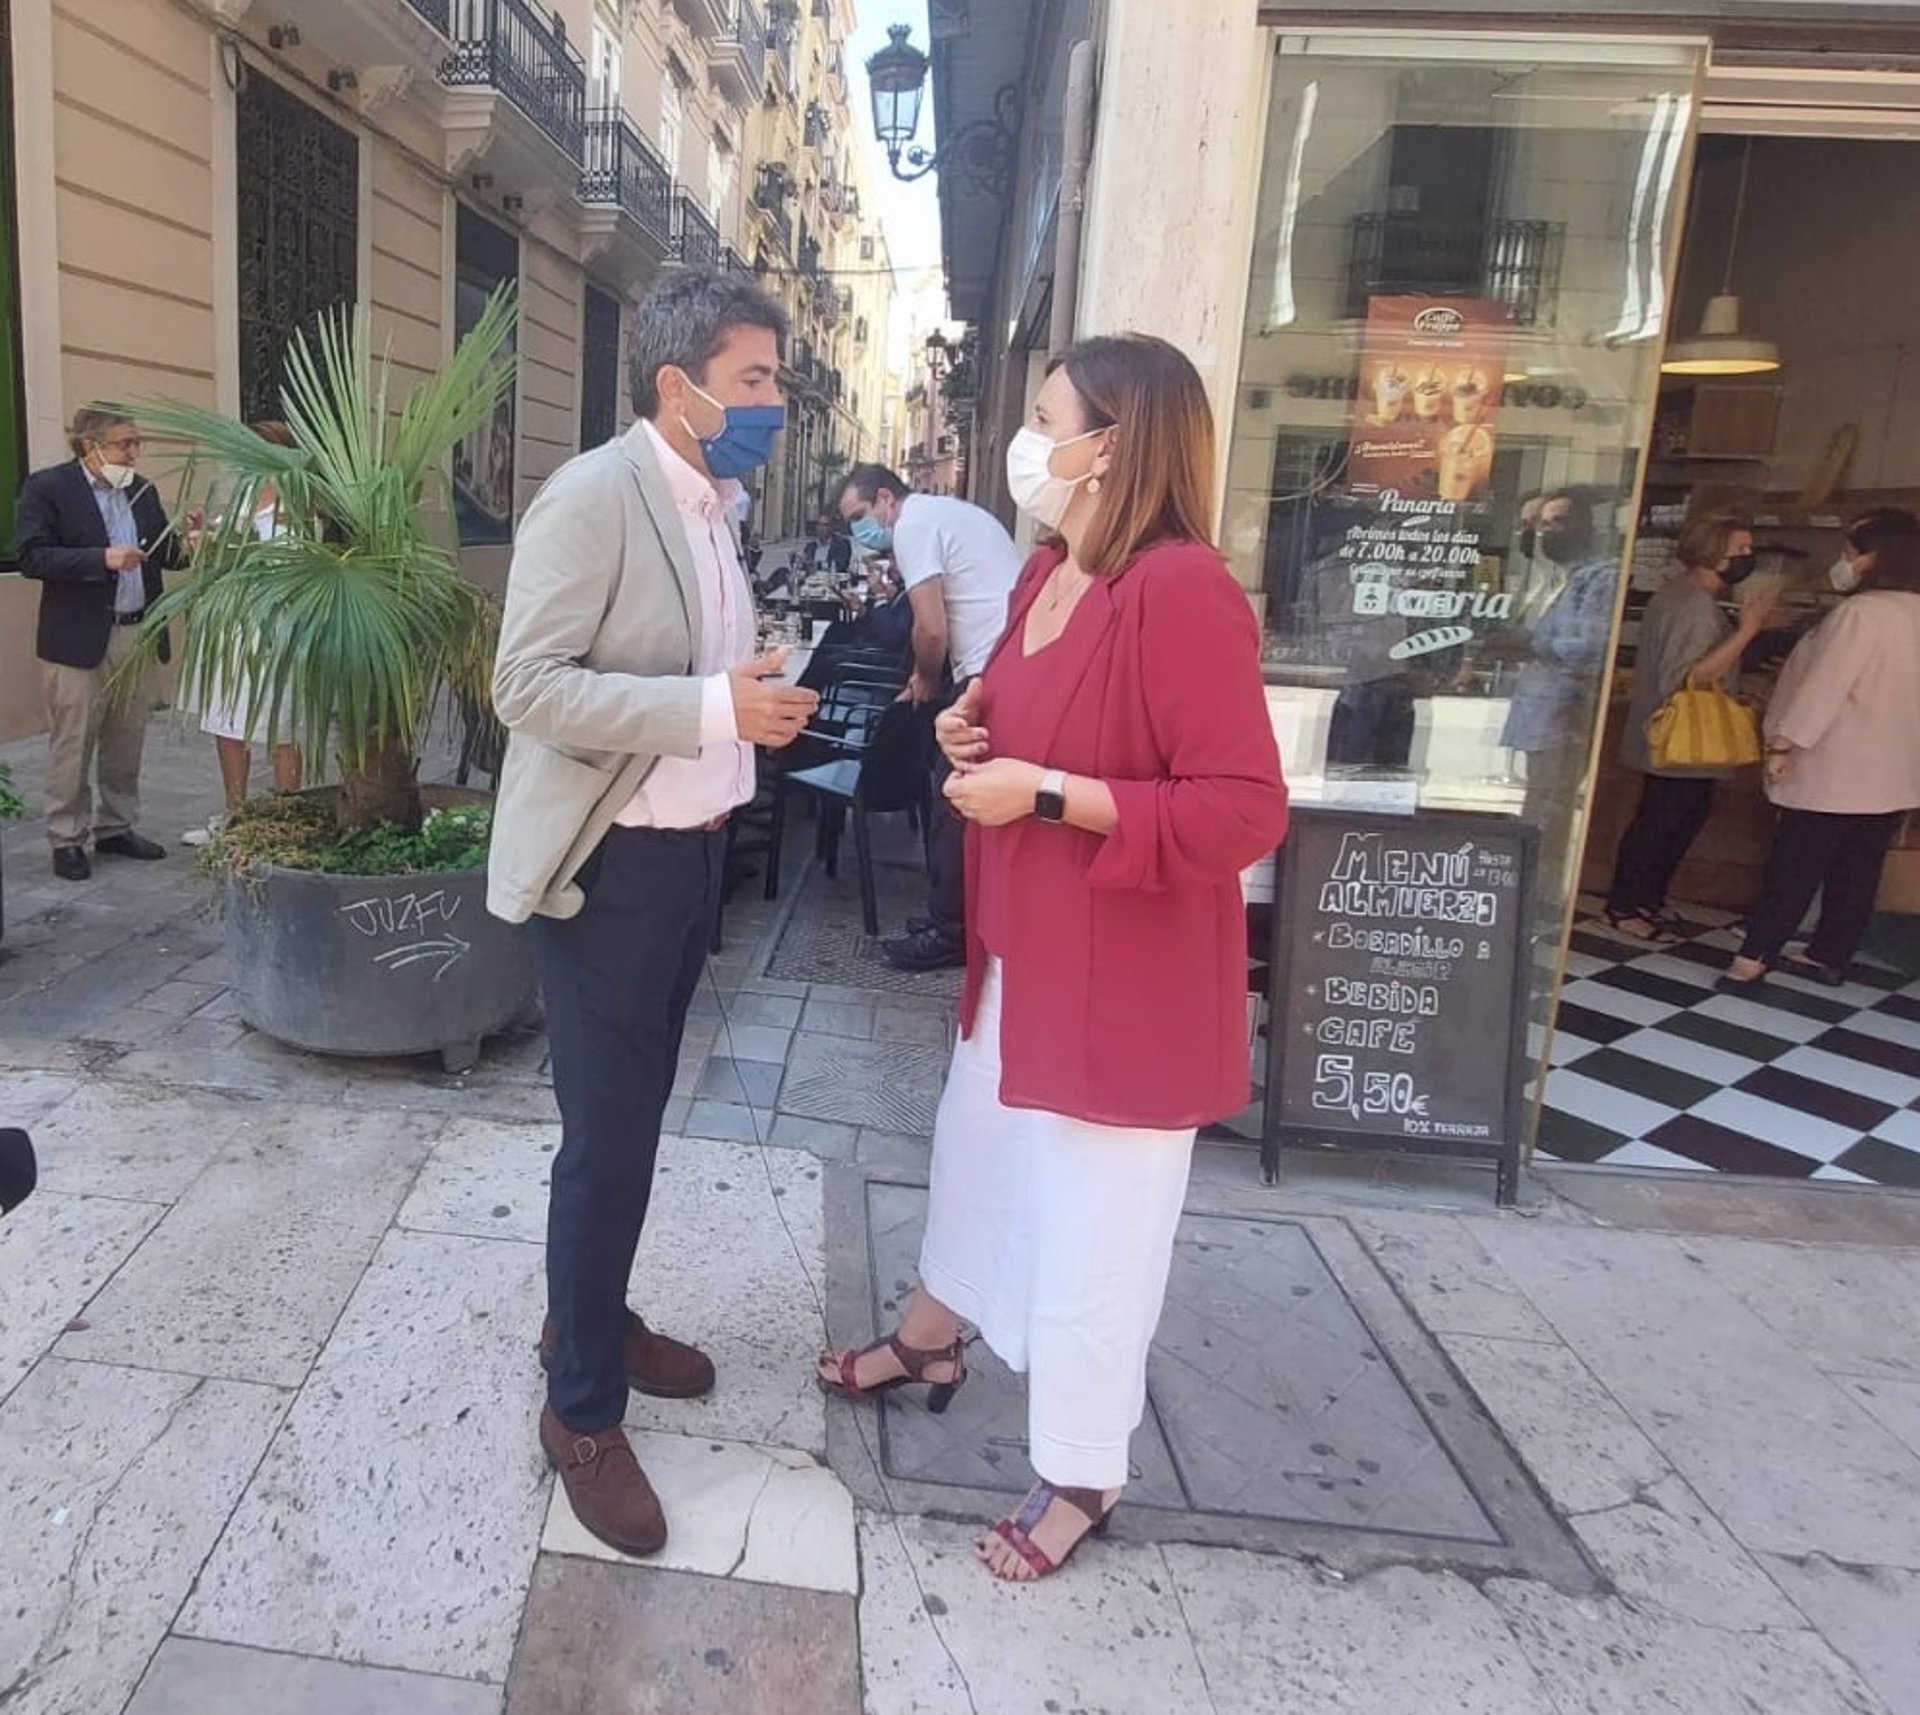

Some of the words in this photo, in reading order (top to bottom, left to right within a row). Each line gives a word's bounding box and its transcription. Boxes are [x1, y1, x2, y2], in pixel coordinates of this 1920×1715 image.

[1380, 489, 1457, 514] Panaria
[1338, 545, 1355, 558] de
[1358, 541, 1405, 560] 7.00h
[1421, 545, 1481, 564] 20.00h
[1398, 530, 1430, 542] todos
[1331, 832, 1474, 887] MENÚ
[1318, 881, 1497, 926] ALMUERZO
[1312, 1054, 1430, 1121] 5,50€
